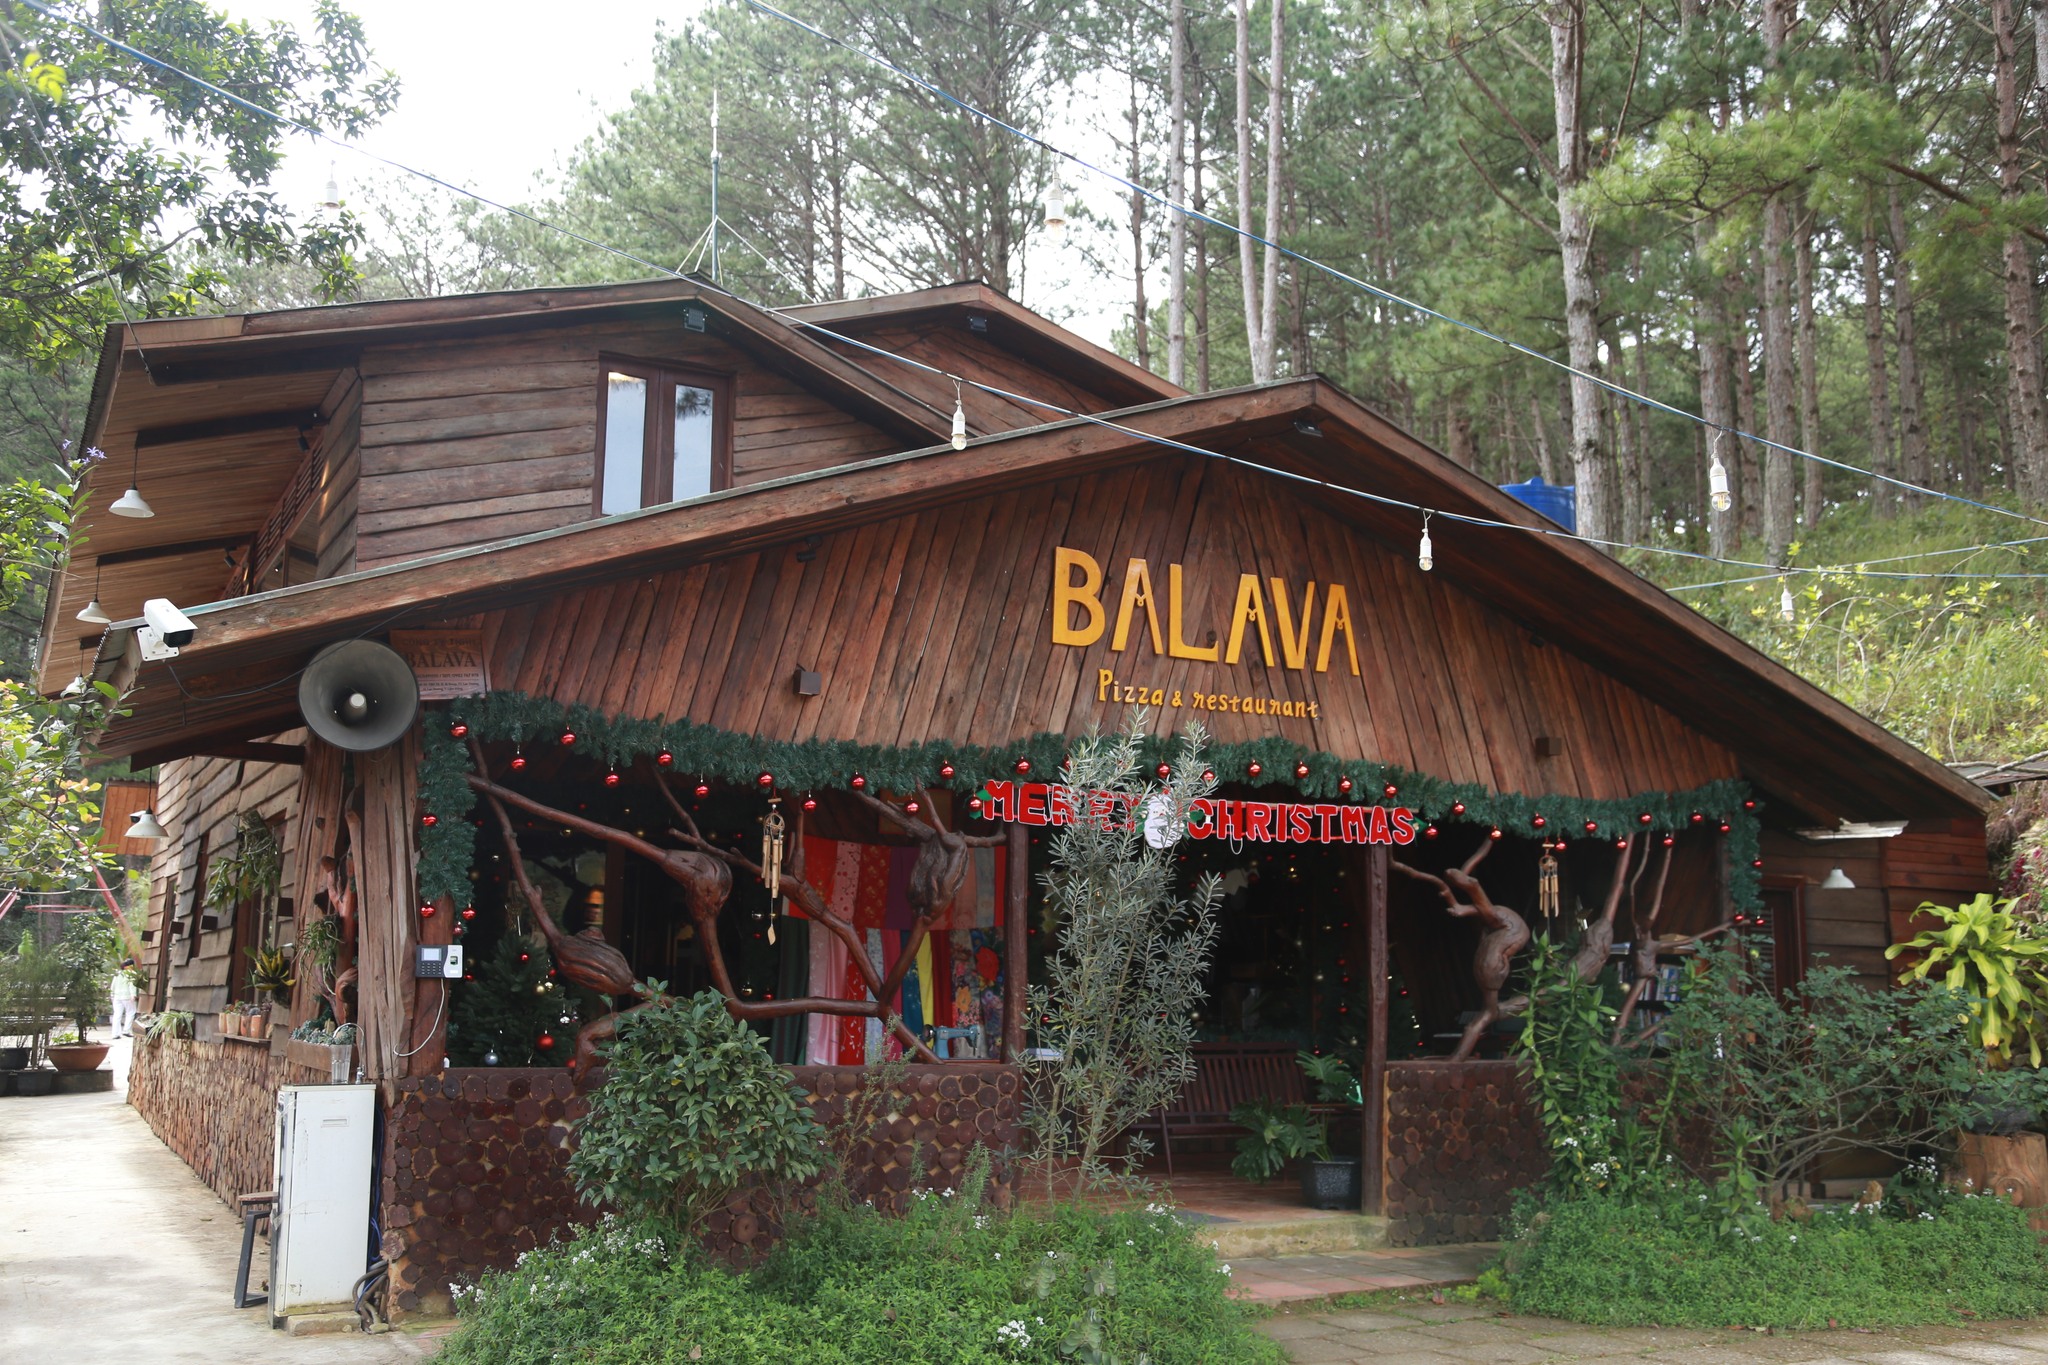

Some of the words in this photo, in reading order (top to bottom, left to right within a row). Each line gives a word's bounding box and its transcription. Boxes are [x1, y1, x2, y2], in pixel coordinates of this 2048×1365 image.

[1052, 546, 1360, 676] BALAVA
[405, 651, 477, 668] BALAVA
[1098, 669, 1163, 706] Pizza
[1171, 690, 1183, 708] &
[1192, 691, 1319, 718] restaurant
[1187, 797, 1416, 845] CHRISTMAS
